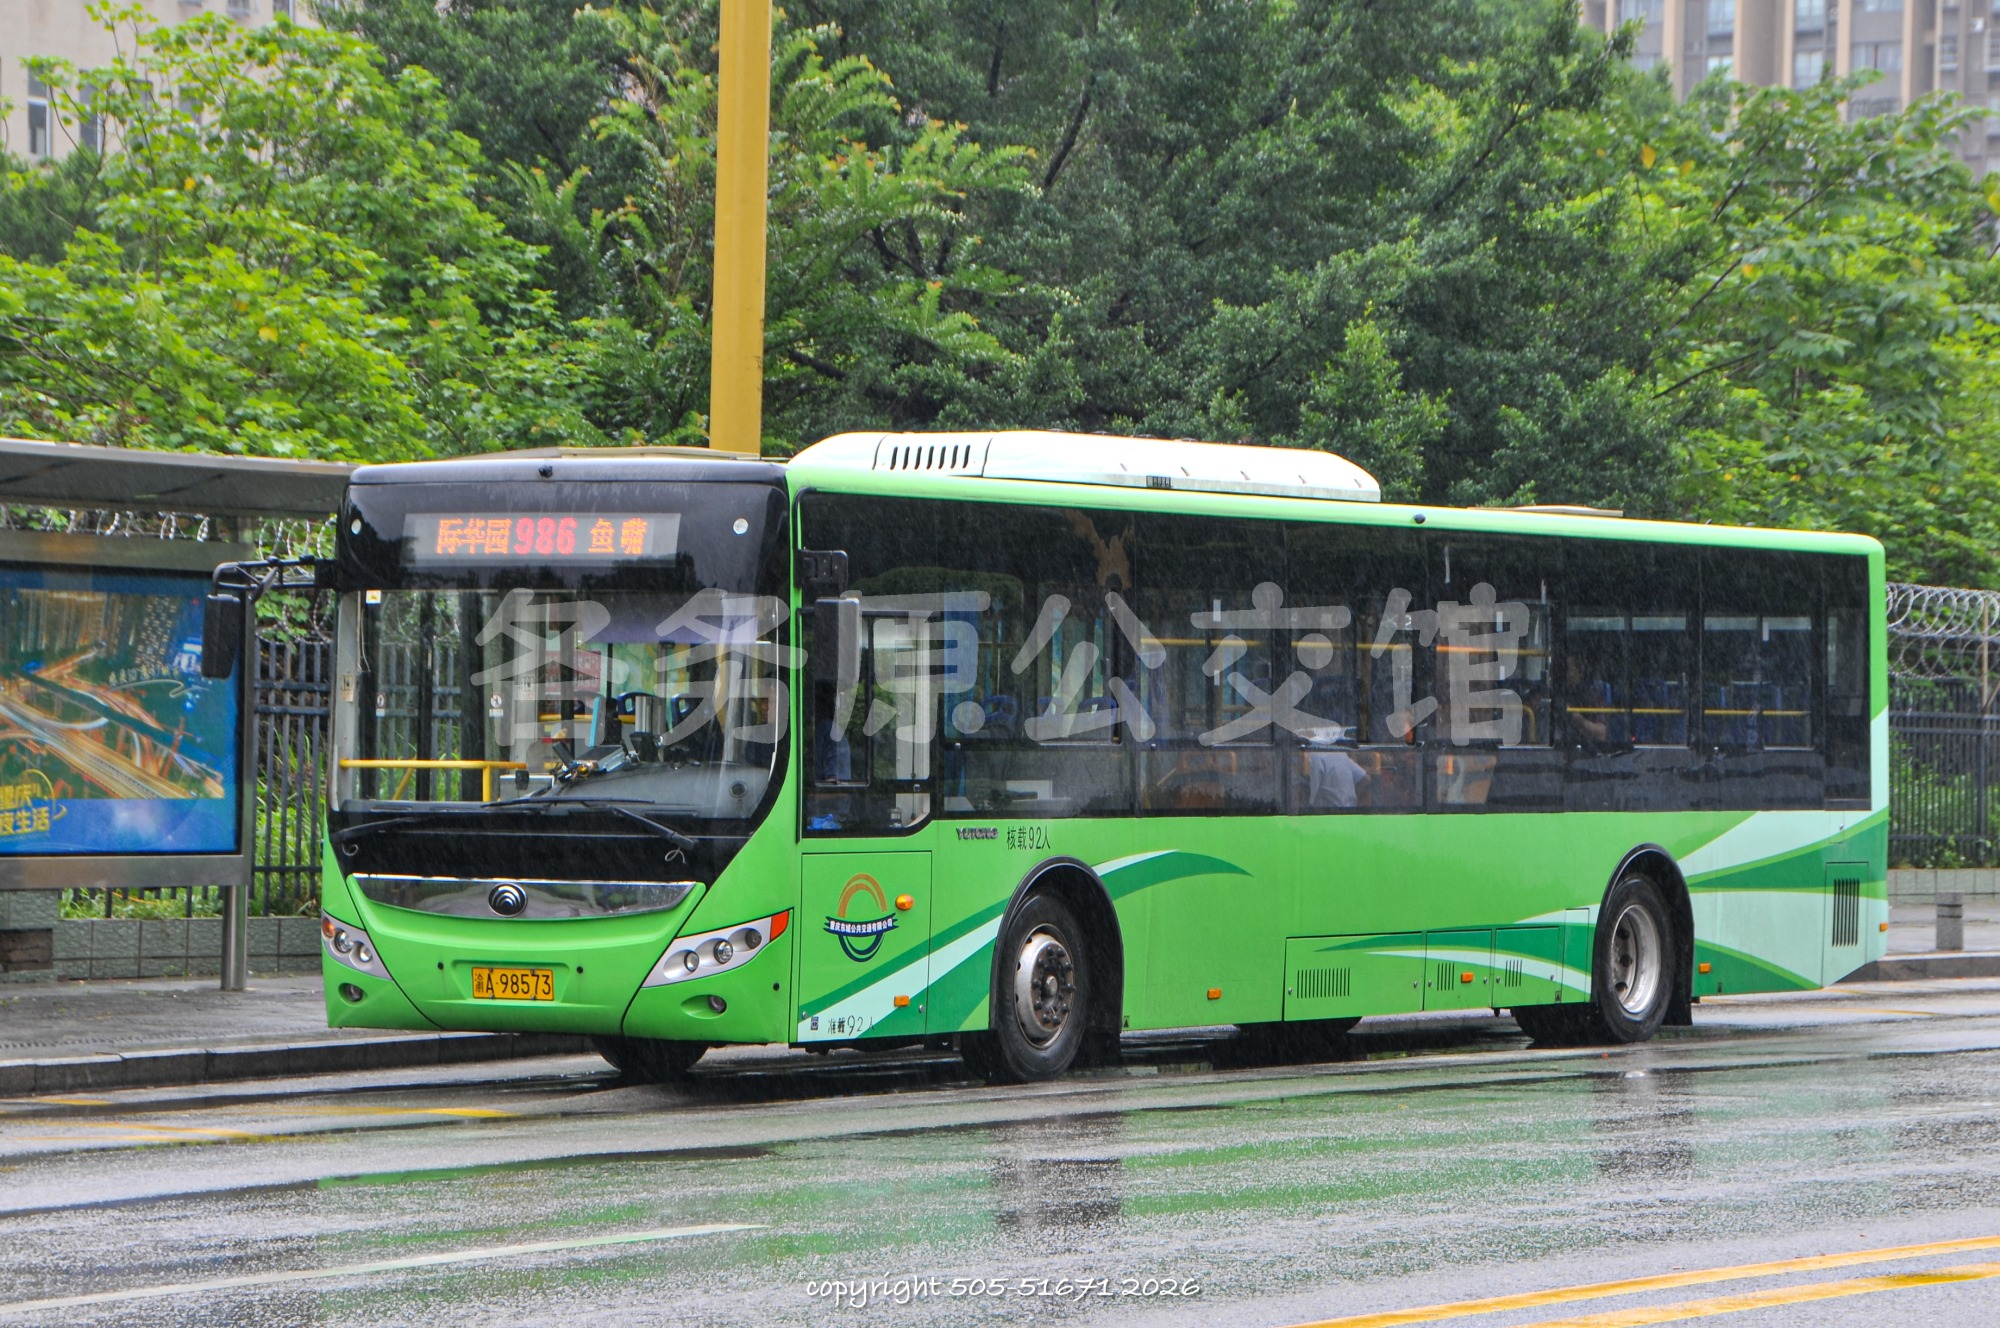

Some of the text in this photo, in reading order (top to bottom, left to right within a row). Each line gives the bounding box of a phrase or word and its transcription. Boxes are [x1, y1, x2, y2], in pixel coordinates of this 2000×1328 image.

[437, 518, 511, 554] 际华园
[514, 517, 577, 555] 986
[1007, 826, 1051, 850] 核载92人
